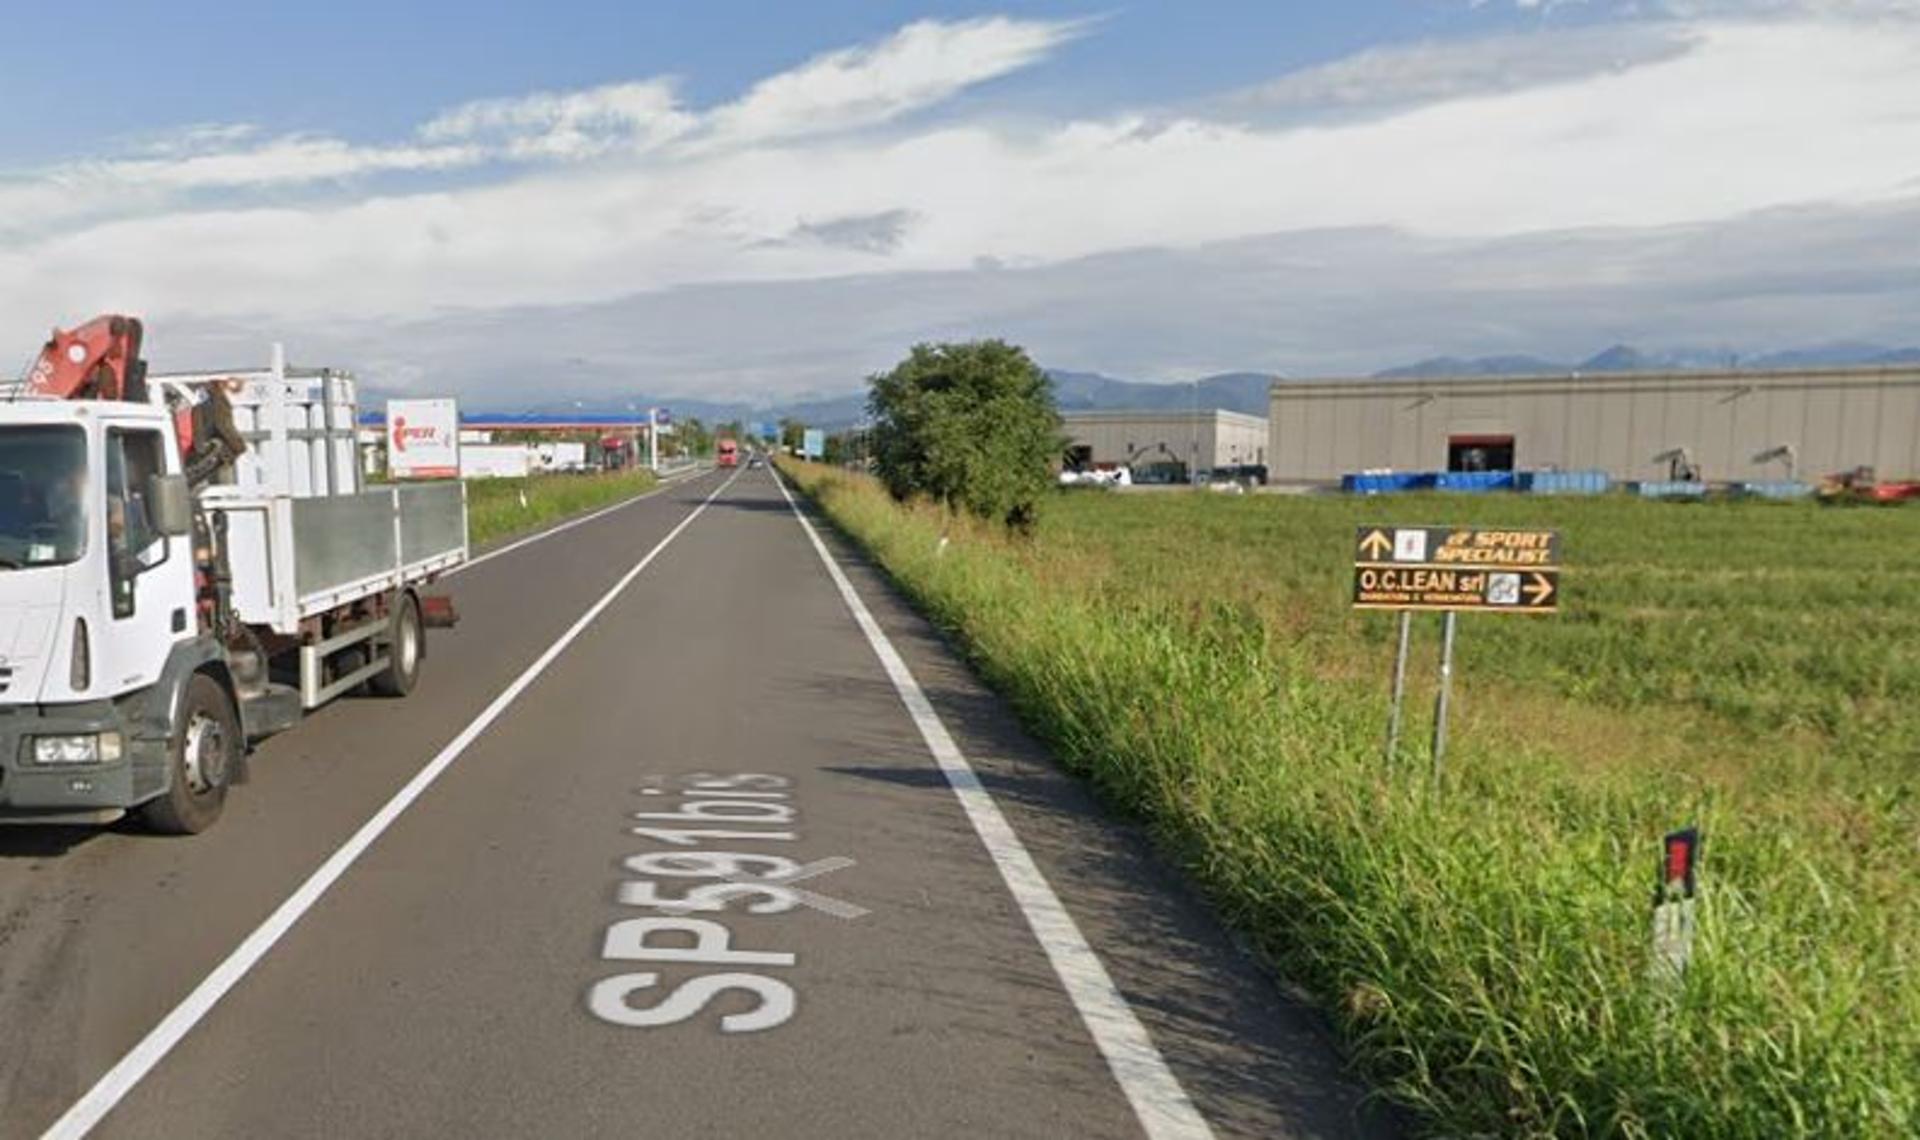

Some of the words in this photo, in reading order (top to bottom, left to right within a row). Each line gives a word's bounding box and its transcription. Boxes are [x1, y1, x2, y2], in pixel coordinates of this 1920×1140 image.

[1473, 531, 1552, 548] SPORT
[1434, 547, 1551, 563] SPECIALIST
[1360, 569, 1456, 591] O.C.LEAN
[1459, 572, 1485, 592] srl
